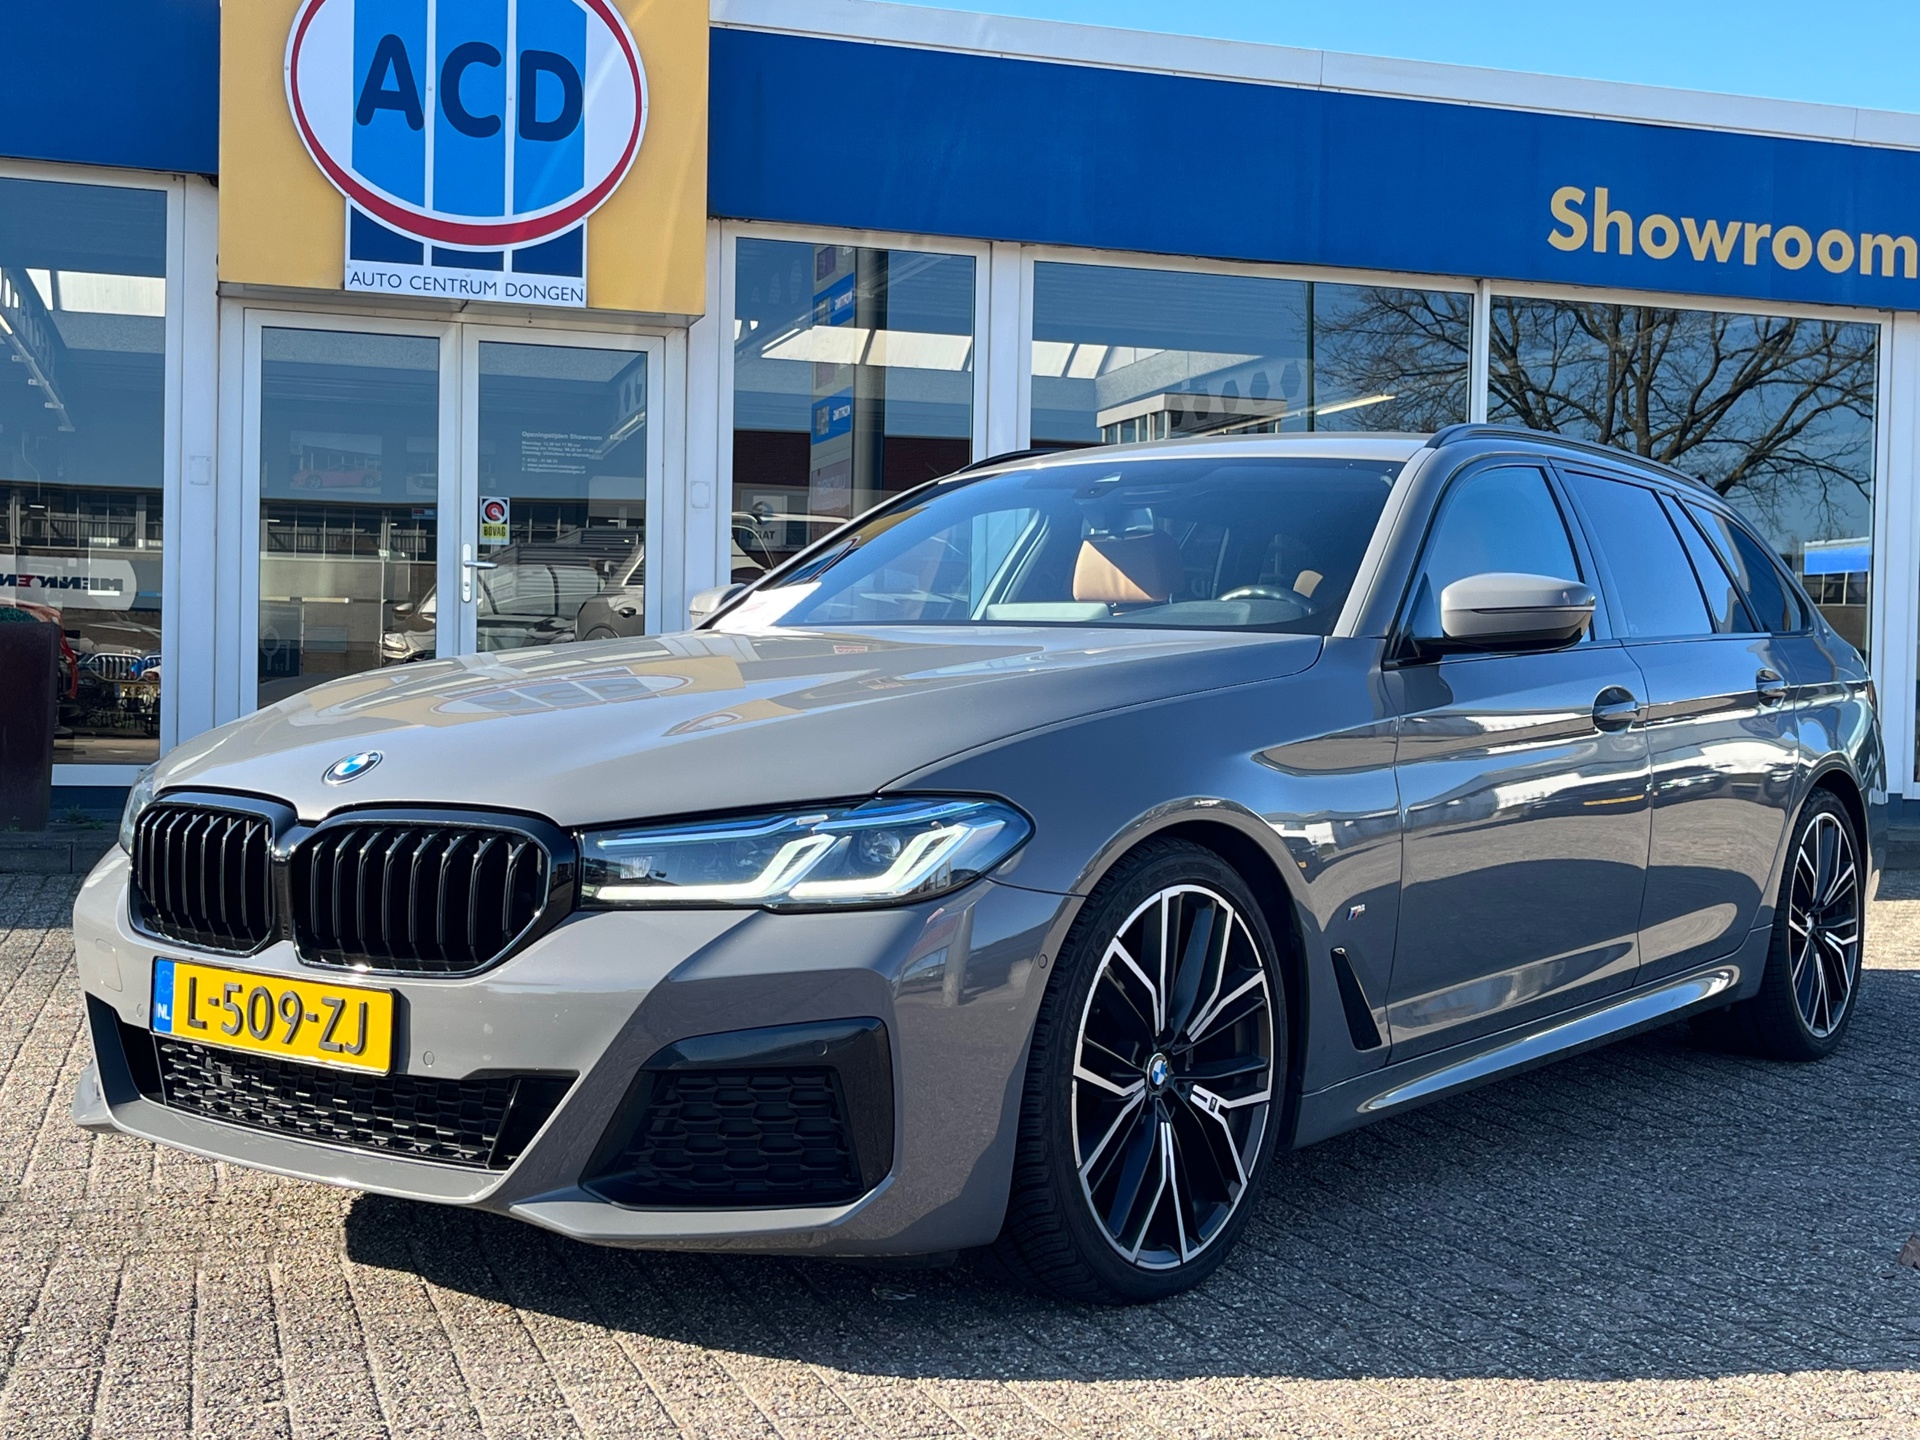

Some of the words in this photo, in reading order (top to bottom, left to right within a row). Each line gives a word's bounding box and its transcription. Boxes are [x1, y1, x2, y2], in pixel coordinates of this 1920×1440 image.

[355, 33, 584, 142] ACD
[1547, 185, 1918, 279] Showroom
[349, 271, 402, 289] AUTO
[409, 275, 498, 296] CENTRUM
[505, 282, 584, 302] DONGEN
[483, 526, 506, 537] BOVAG
[156, 1003, 171, 1021] NL
[187, 976, 370, 1056] L-509-ZJ
